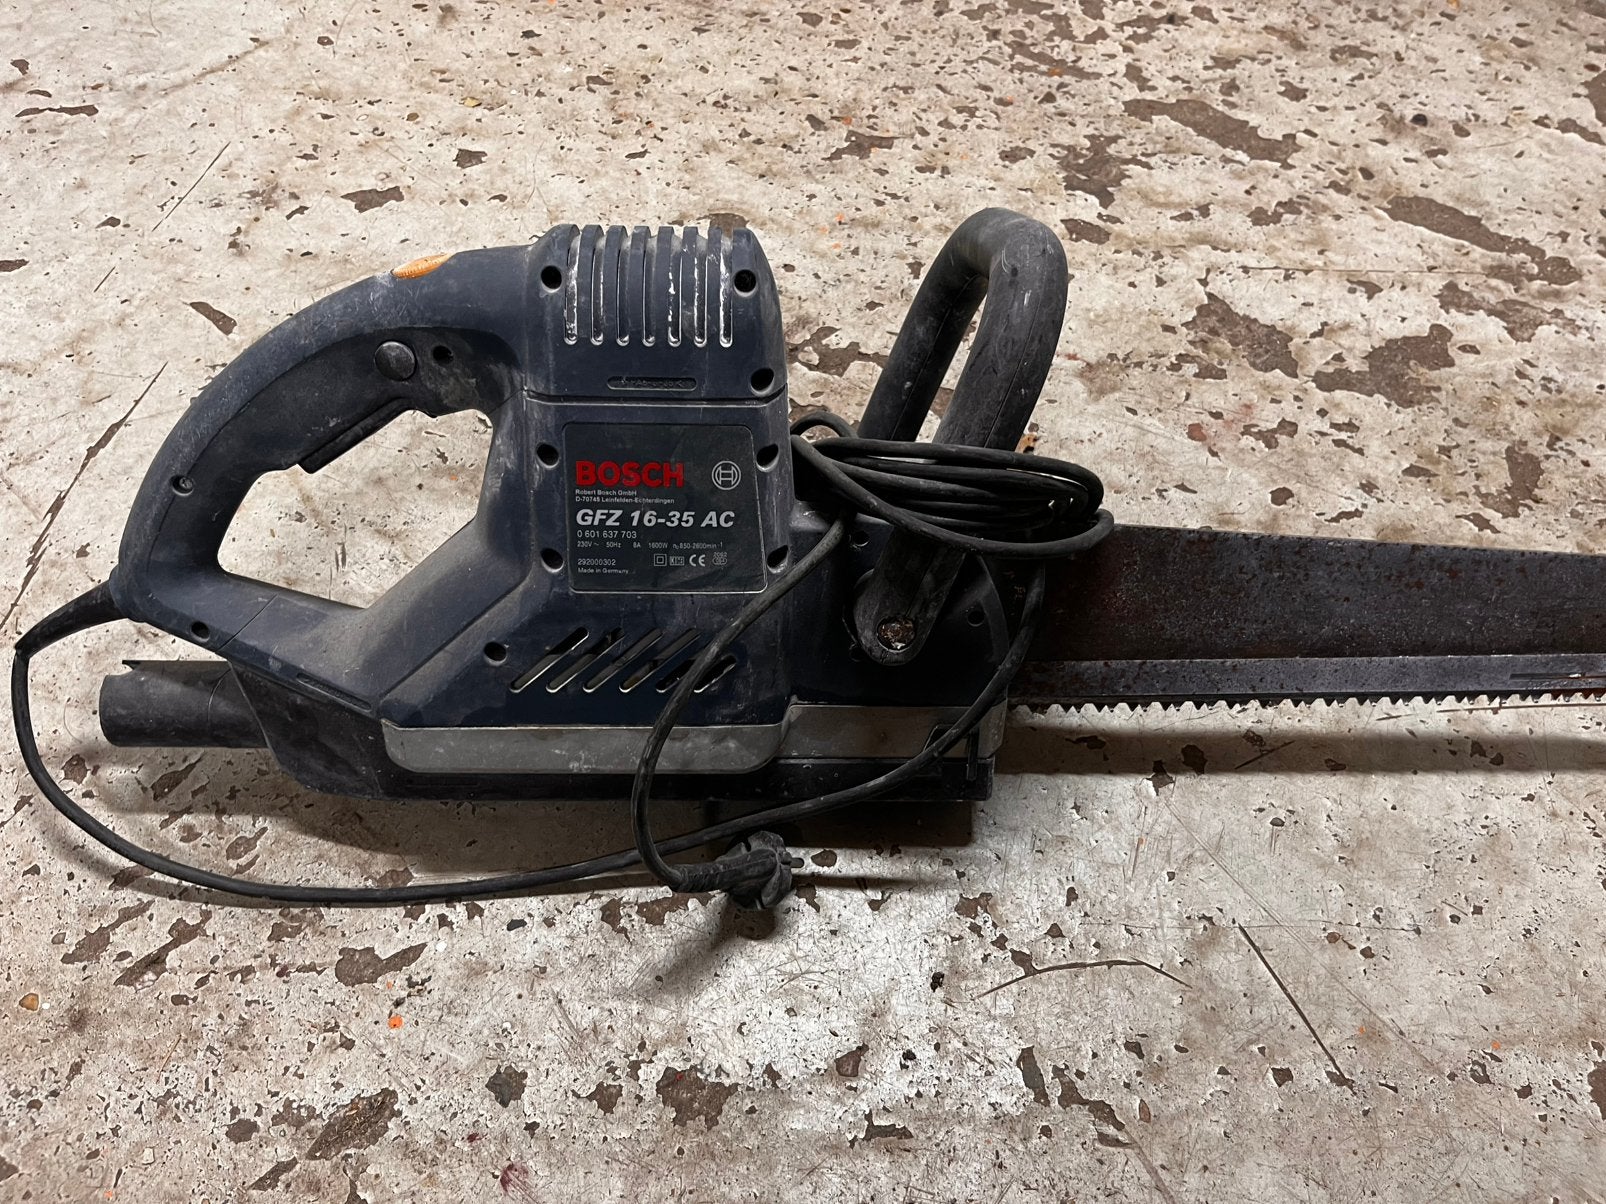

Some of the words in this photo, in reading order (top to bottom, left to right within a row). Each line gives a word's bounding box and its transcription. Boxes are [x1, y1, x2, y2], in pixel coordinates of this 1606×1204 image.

[575, 460, 685, 488] BOSCH
[601, 497, 675, 505] Leinfelden-Echterdingen
[576, 508, 623, 526] GFZ
[630, 510, 696, 528] 16-35
[700, 510, 735, 528] AC
[576, 530, 583, 538] 0
[584, 530, 600, 538] 601
[602, 530, 619, 539] 637
[621, 531, 637, 539] 703
